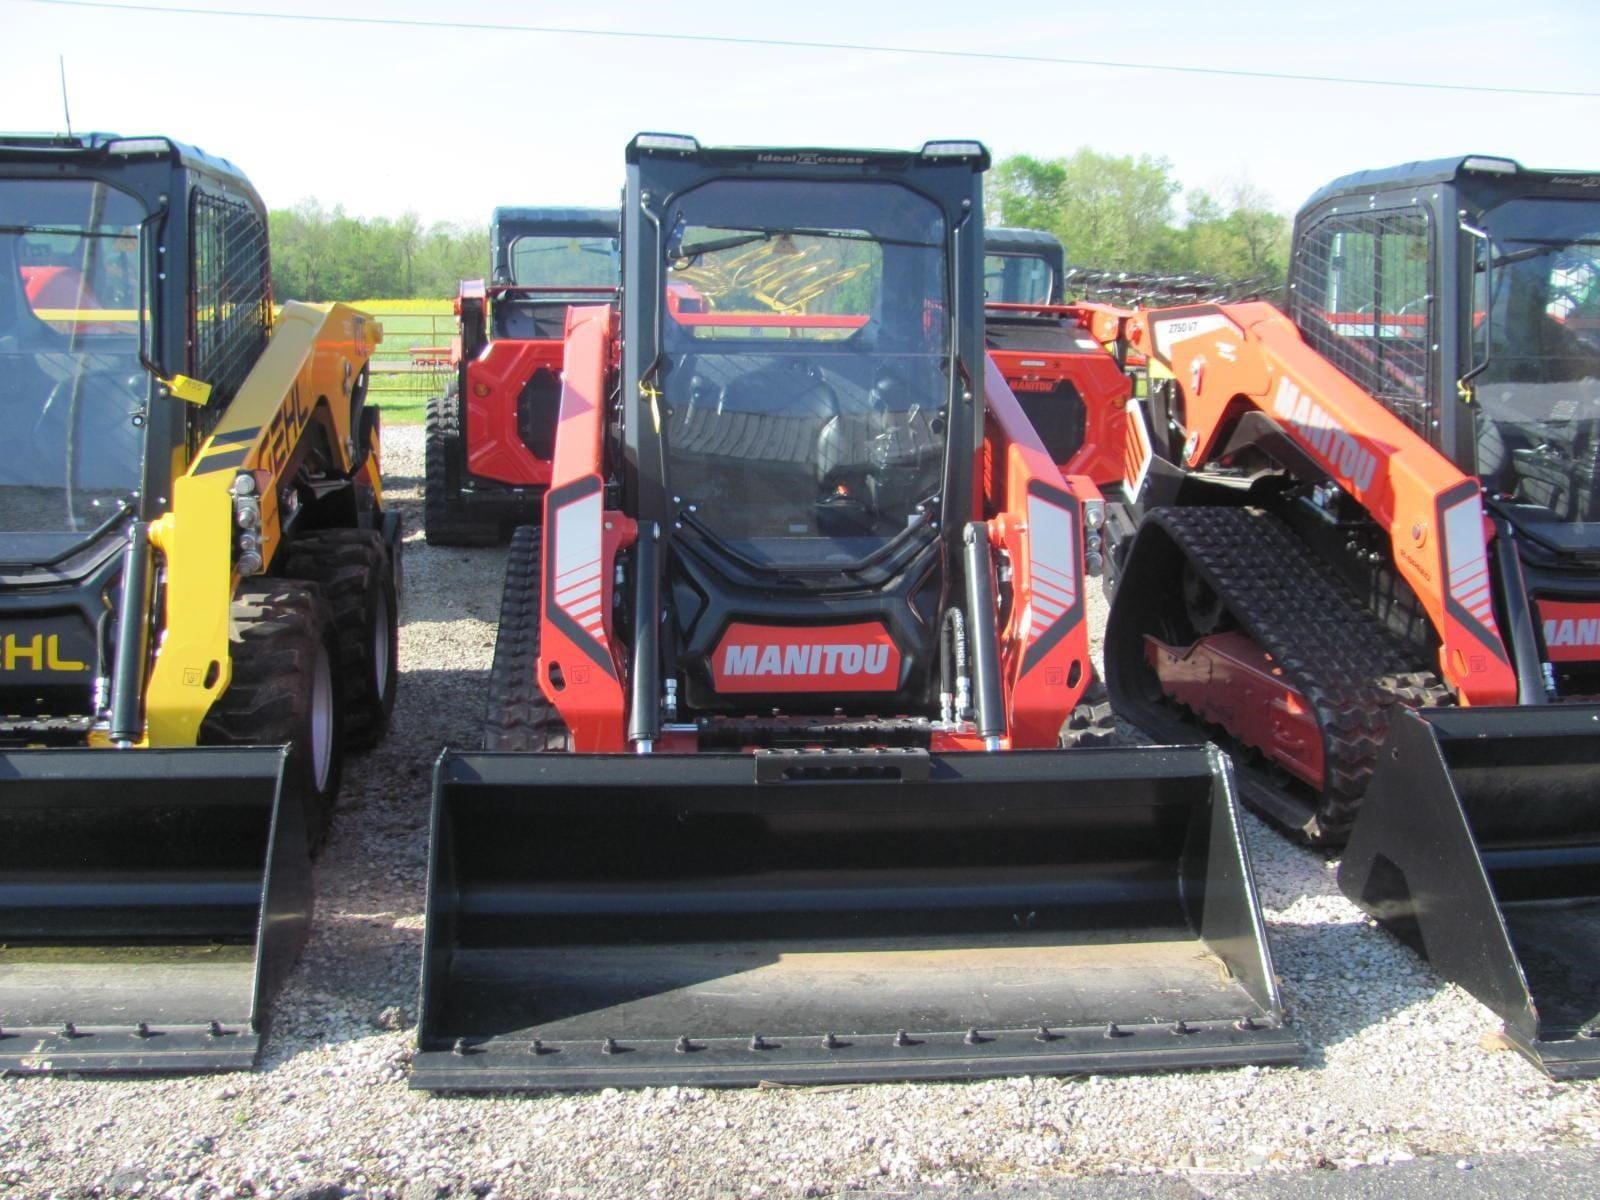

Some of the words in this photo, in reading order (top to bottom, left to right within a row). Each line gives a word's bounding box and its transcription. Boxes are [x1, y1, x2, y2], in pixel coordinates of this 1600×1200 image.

[1274, 376, 1377, 493] MANITOU
[0, 634, 85, 671] HL
[723, 644, 889, 675] MANITOU
